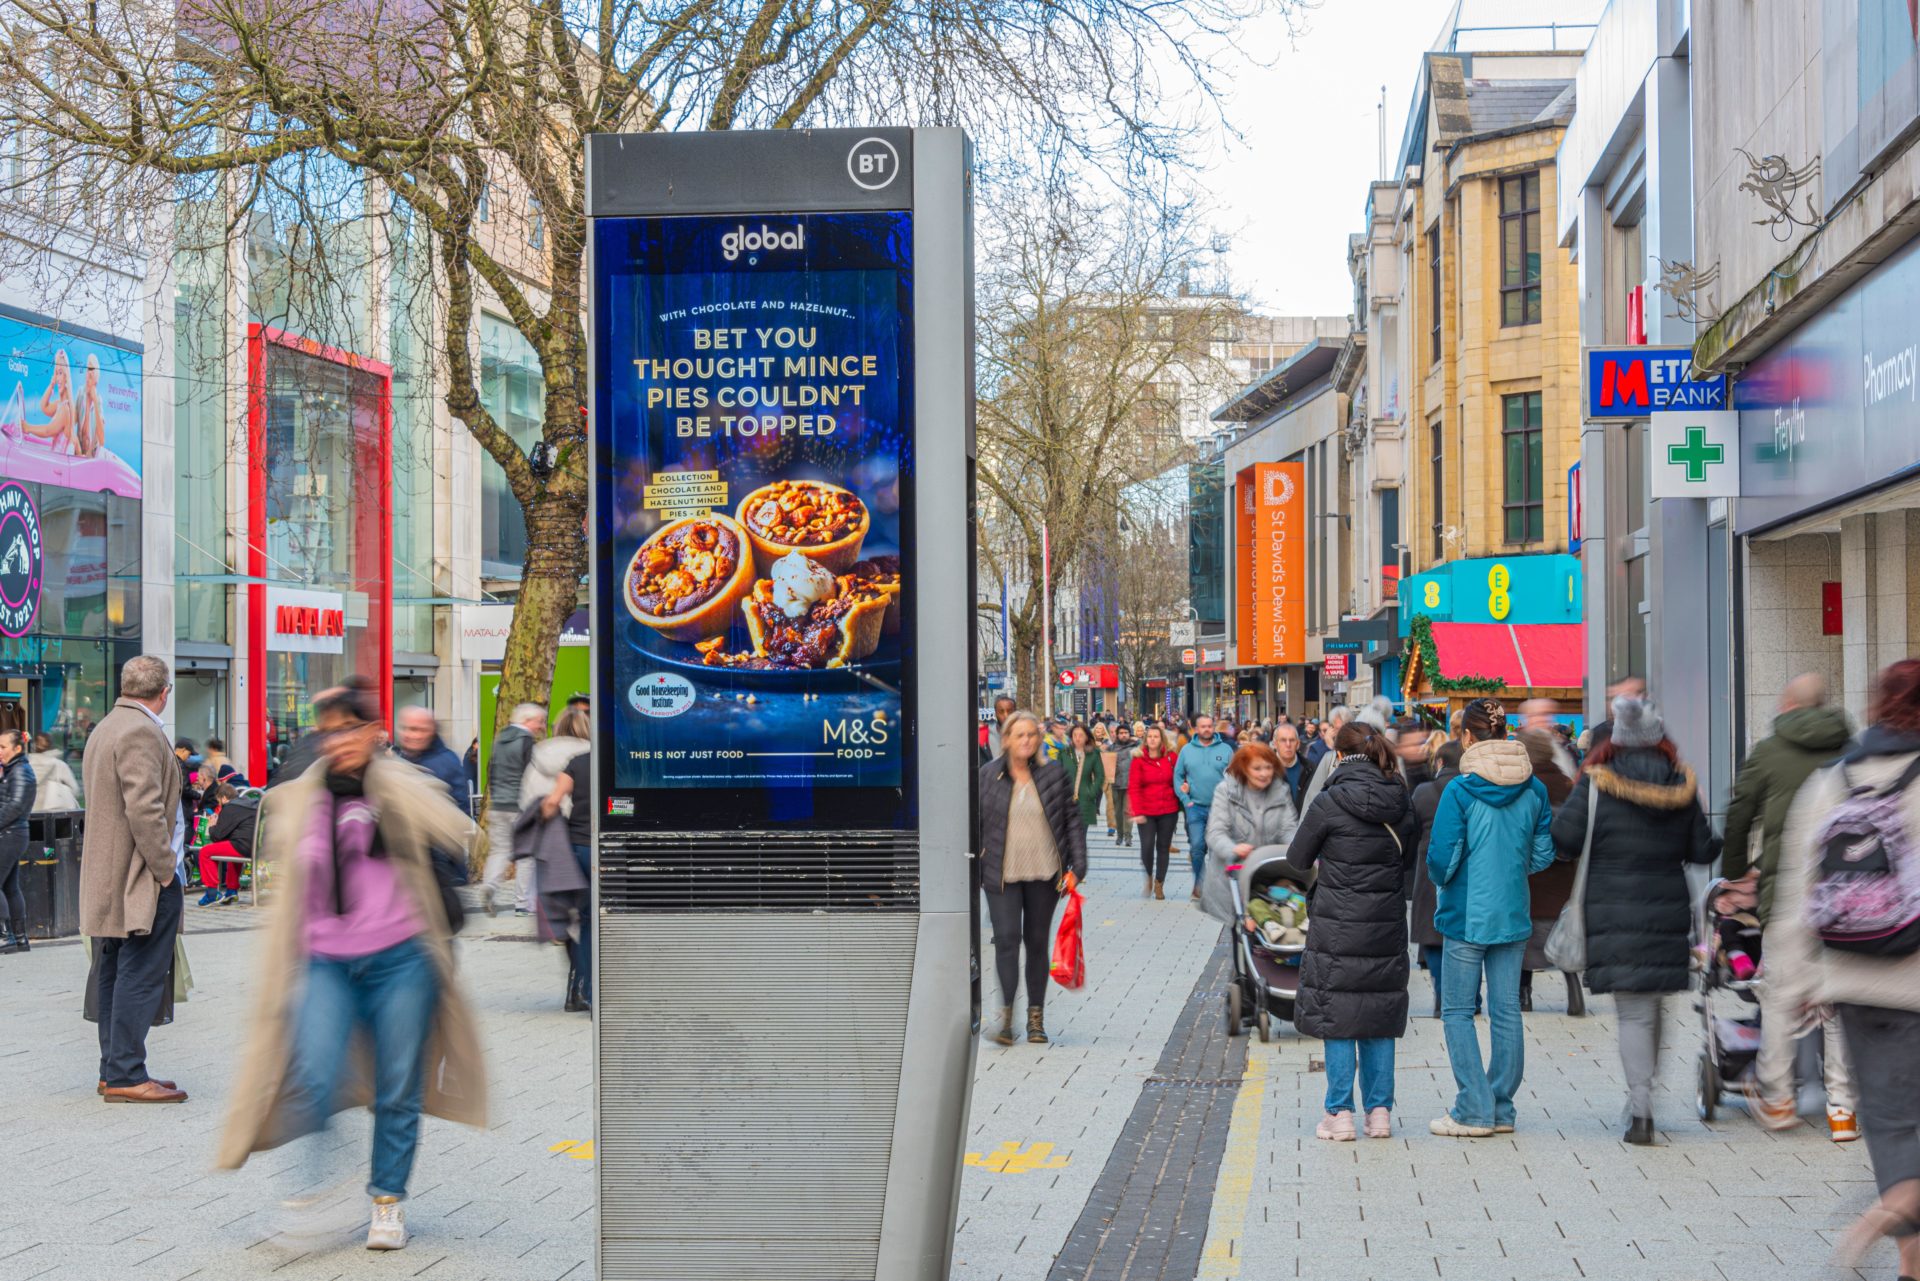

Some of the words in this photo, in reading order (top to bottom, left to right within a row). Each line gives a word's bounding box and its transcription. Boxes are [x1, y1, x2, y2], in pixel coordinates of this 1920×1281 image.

[859, 154, 887, 173] BT
[721, 224, 804, 261] global
[659, 309, 687, 323] WITH
[691, 301, 756, 316] CHOCOLATE
[761, 301, 785, 309] AND
[790, 301, 856, 320] HAZELNUT...
[694, 328, 747, 350] BET
[756, 327, 816, 349] YOU
[633, 357, 775, 380] THOUGHT
[784, 355, 877, 378] MINCE
[1864, 344, 1917, 408] Pharmacy
[647, 387, 709, 408] PIES
[717, 385, 865, 408] COULDN'T
[1654, 387, 1721, 406] BANK
[676, 416, 711, 437] BE
[720, 415, 837, 437] TOPPED
[659, 474, 713, 482] COLLECTION
[651, 485, 701, 495] CHOCOLATE
[650, 498, 695, 506] HAZELNUT
[696, 509, 706, 517] £4
[0, 490, 20, 514] HMV
[22, 503, 40, 560] SHOP
[1271, 510, 1285, 527] St
[1271, 531, 1286, 582] David's
[0, 604, 13, 628] ST.
[14, 598, 34, 629] 1921
[1272, 586, 1286, 623] Dewi
[1272, 625, 1286, 658] Sant
[635, 684, 650, 696] Good
[651, 684, 689, 697] Housekeeping
[652, 697, 674, 708] Institute
[823, 719, 888, 745] M&S
[629, 751, 651, 760] THIS
[654, 751, 663, 760] IS
[666, 751, 687, 760] NOT
[689, 751, 712, 759] JUST
[716, 750, 744, 759] FOOD
[836, 748, 873, 759] FOOD
